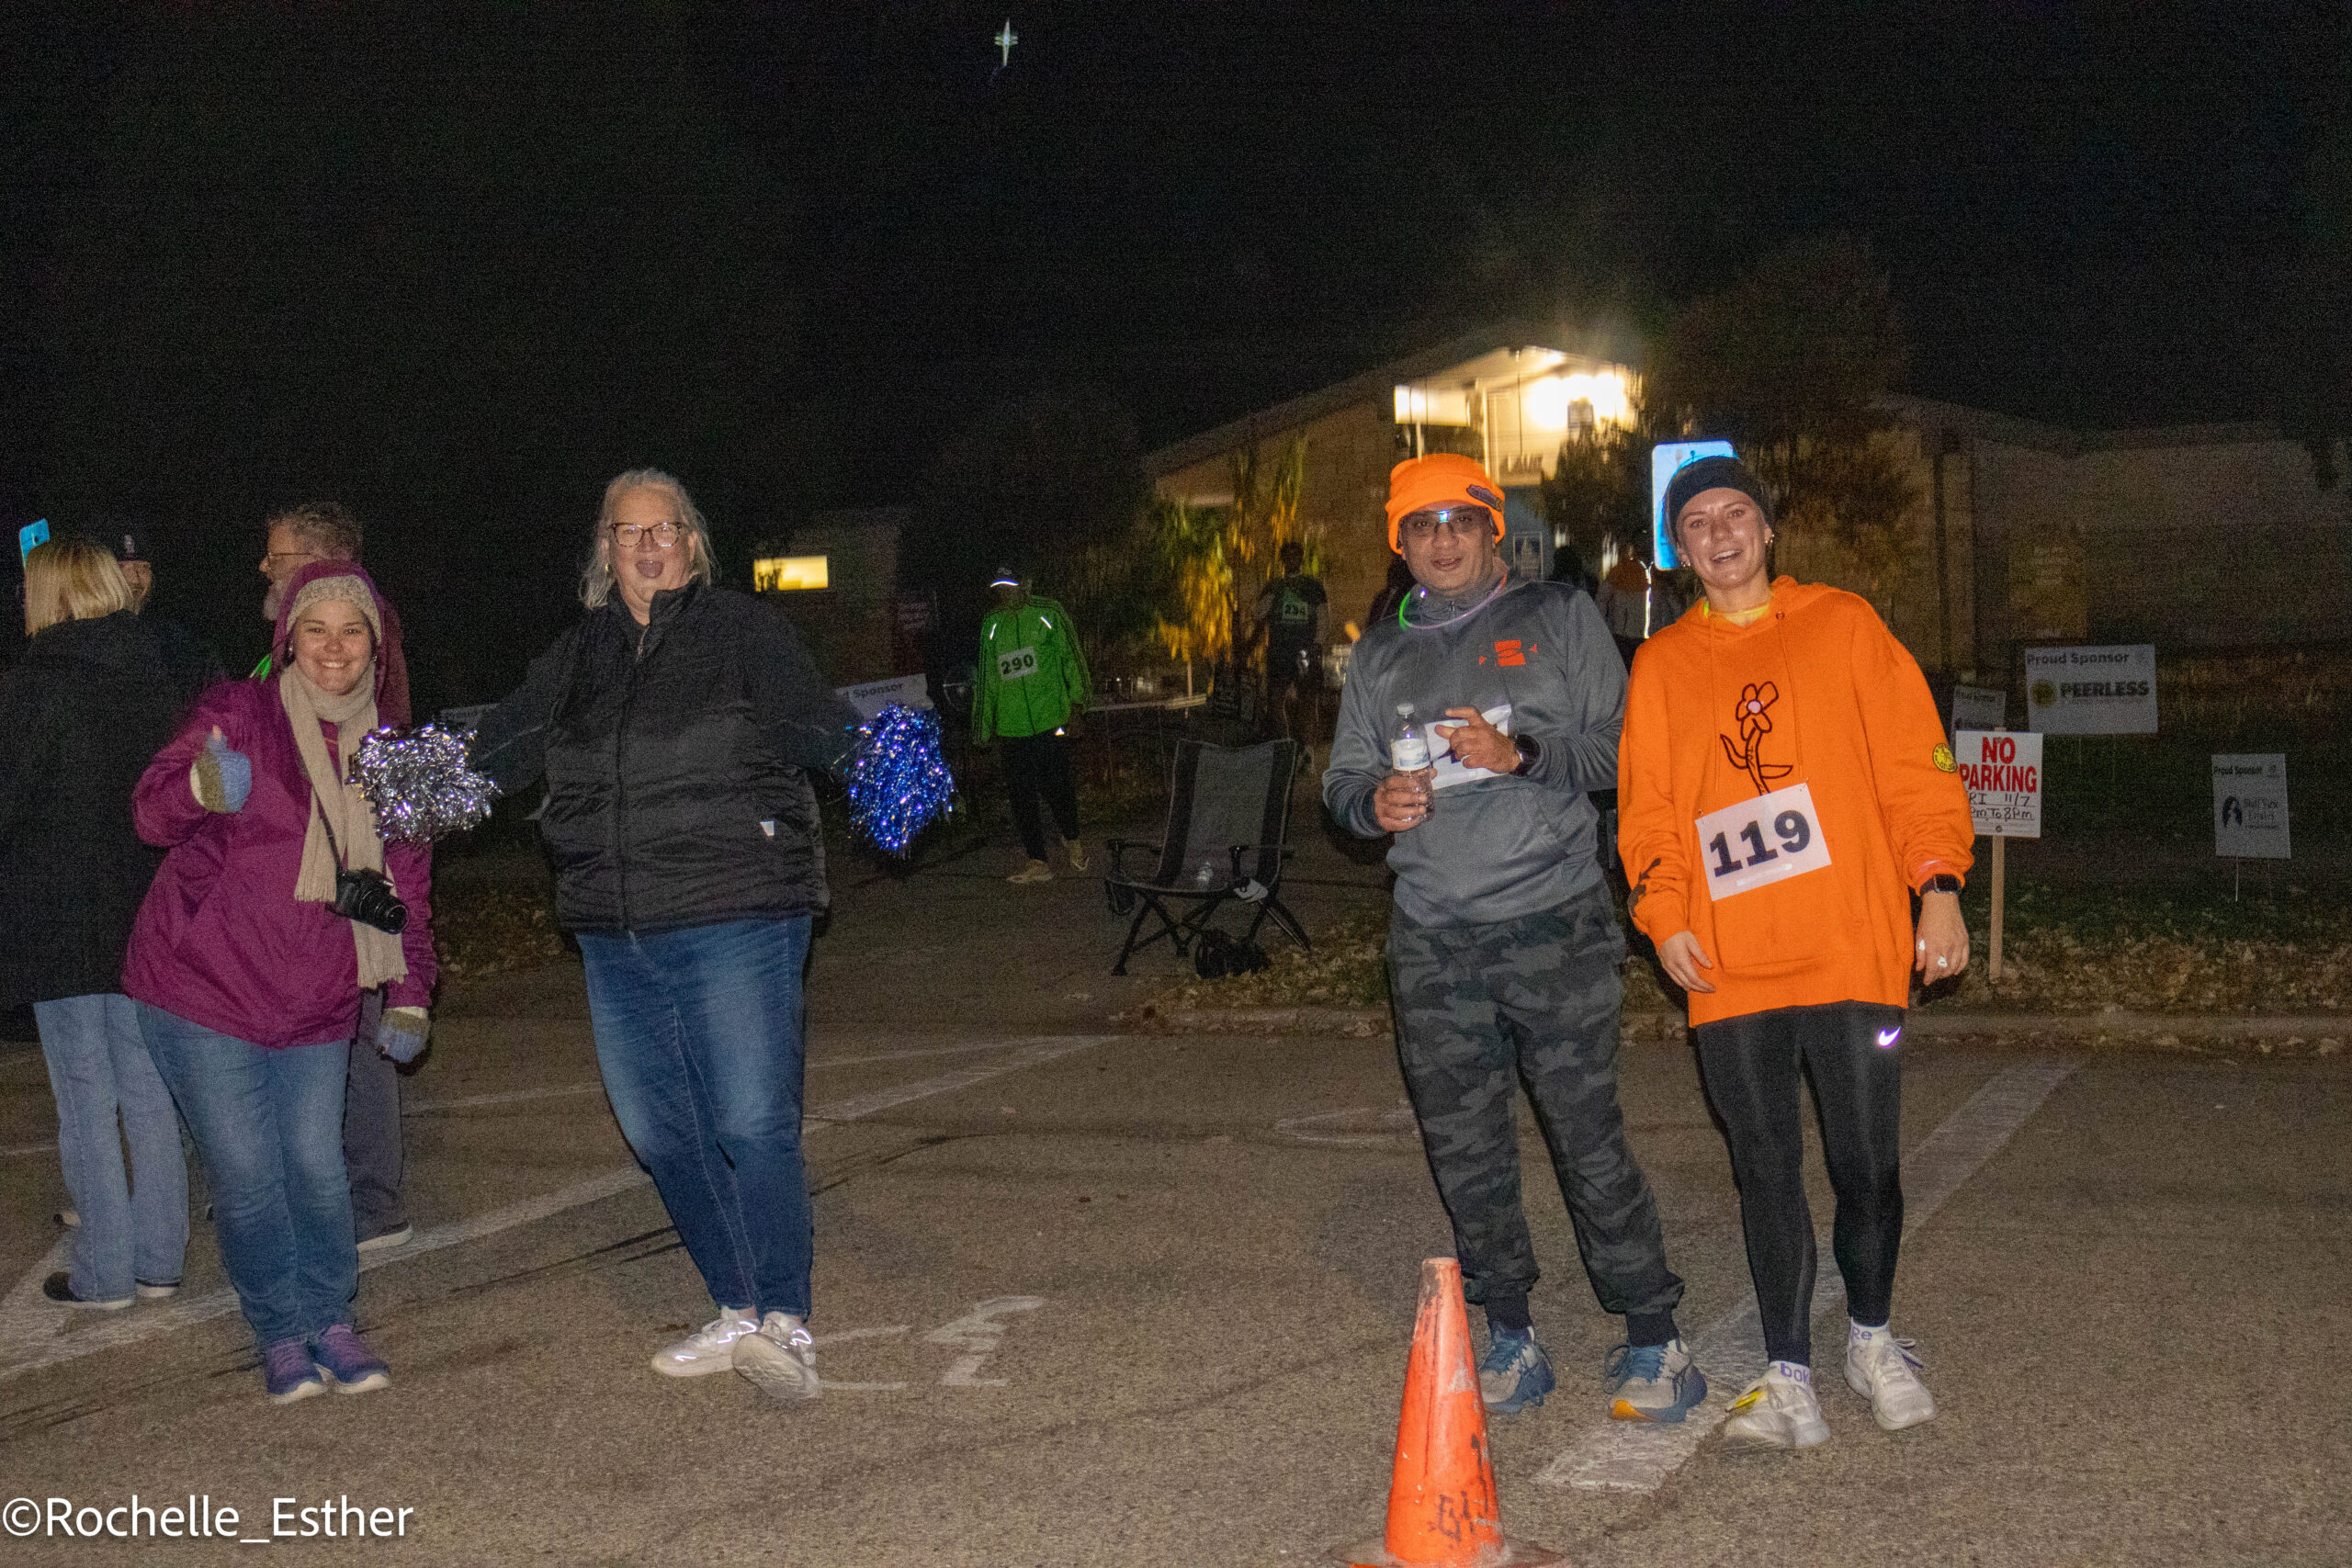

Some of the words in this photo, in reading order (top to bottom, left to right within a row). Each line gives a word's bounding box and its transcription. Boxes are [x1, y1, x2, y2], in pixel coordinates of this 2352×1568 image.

[1001, 654, 1034, 674] 290
[2027, 653, 2067, 665] Proud
[2071, 652, 2130, 666] Sponsor
[853, 683, 903, 699] Sponsor
[2061, 681, 2150, 698] PEERLESS
[1982, 737, 2016, 764] NO
[1959, 763, 2037, 793] PARKING
[1968, 792, 1986, 805] RI
[2005, 793, 2030, 807] 11/7
[1709, 809, 1810, 878] 119
